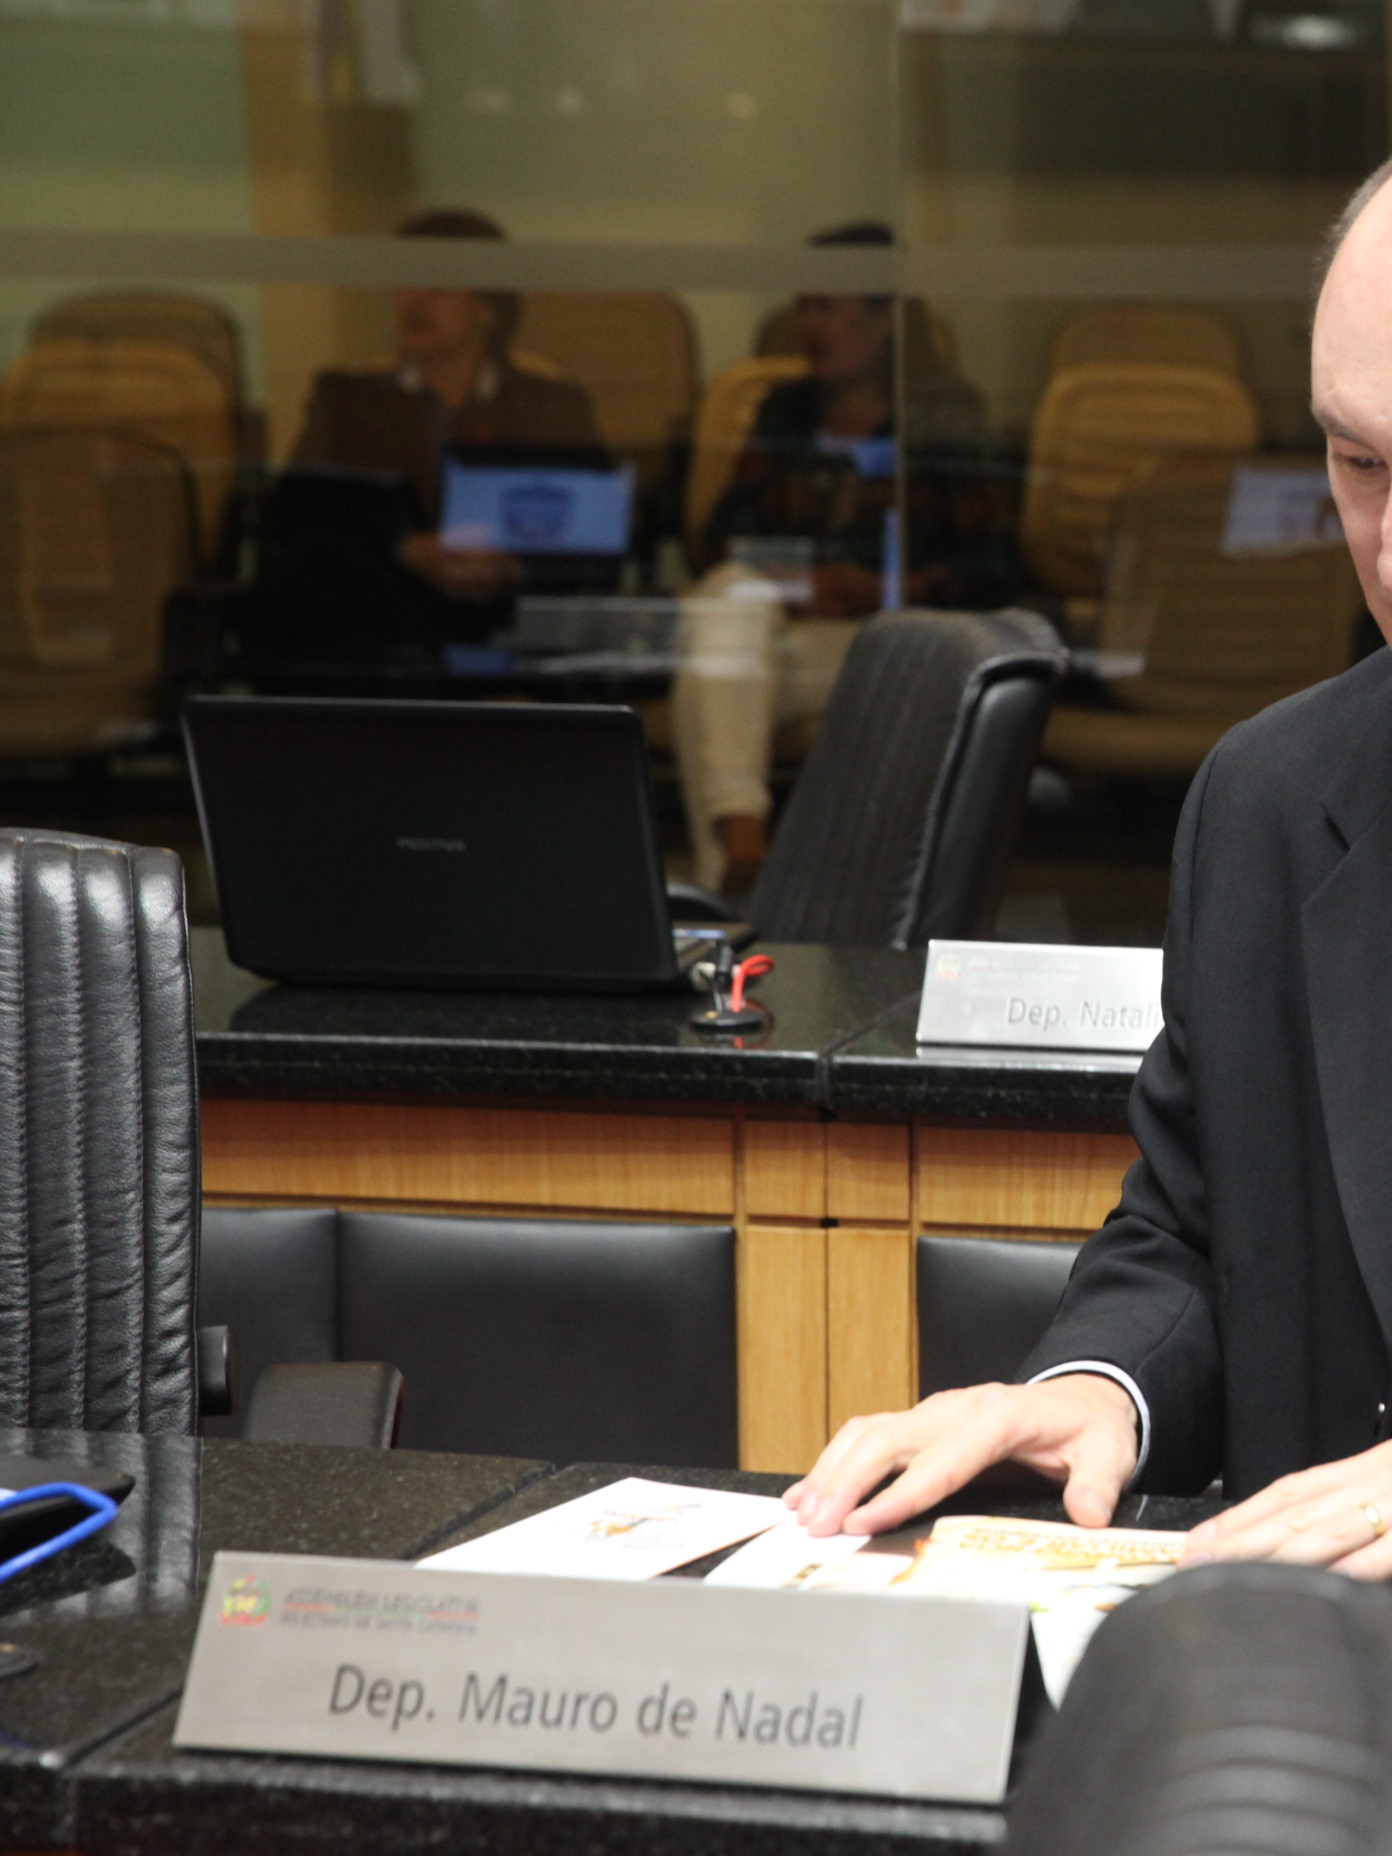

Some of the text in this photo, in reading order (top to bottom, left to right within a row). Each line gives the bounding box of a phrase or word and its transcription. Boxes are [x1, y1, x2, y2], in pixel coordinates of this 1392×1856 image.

[1007, 997, 1067, 1032] Dep.
[328, 1662, 864, 1749] Dep. Mauro de Nadal
